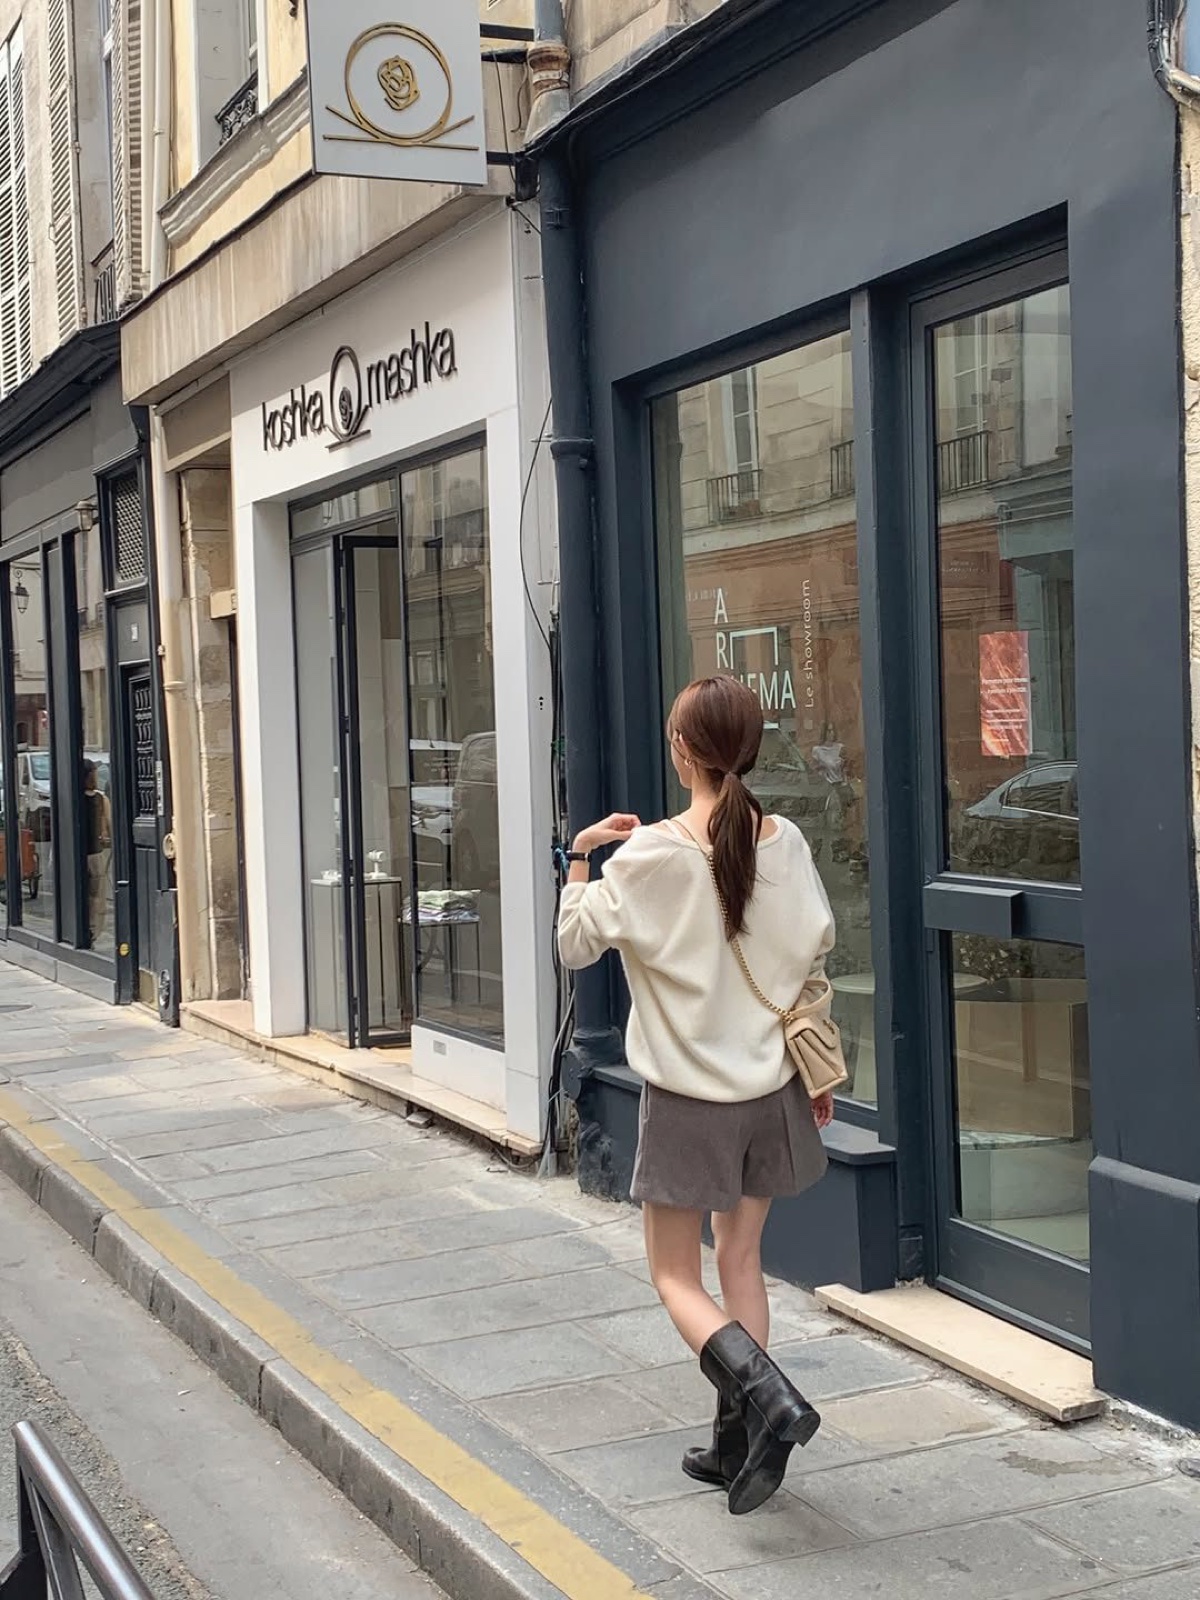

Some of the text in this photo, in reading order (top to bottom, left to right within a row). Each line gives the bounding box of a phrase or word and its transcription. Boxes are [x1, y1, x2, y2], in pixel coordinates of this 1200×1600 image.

[262, 321, 457, 451] koshka mashka
[802, 579, 814, 708] Le showroom
